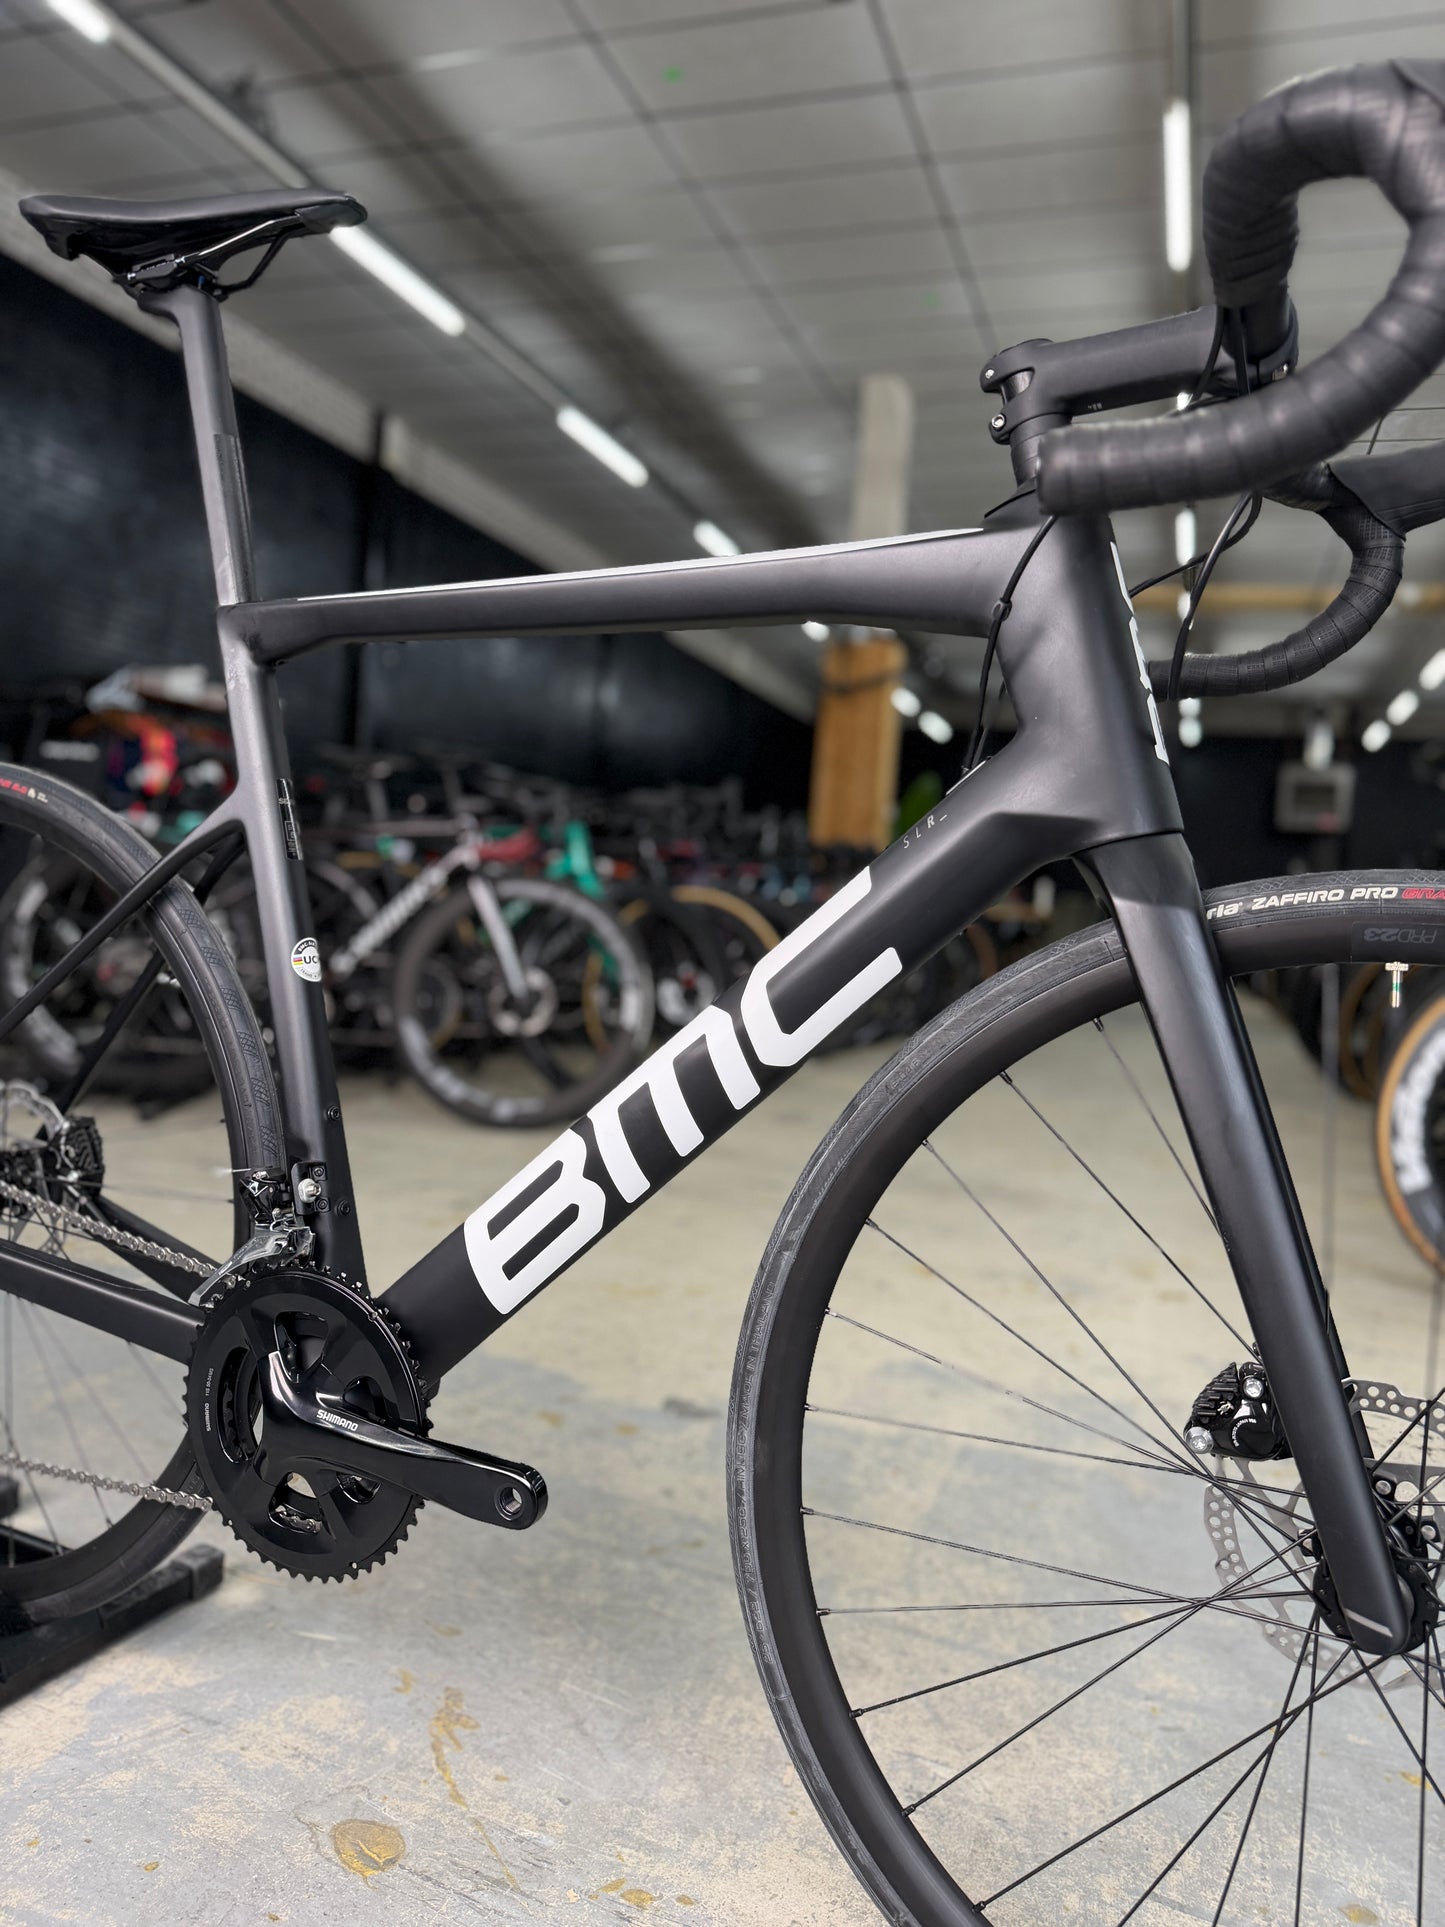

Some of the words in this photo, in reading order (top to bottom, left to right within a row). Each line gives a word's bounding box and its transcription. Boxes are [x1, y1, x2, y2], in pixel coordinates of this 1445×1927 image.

[1252, 889, 1344, 911] ZAFFIRO
[1350, 887, 1398, 900] PRO
[1363, 928, 1438, 944] PRD23
[464, 866, 903, 1315] BMC
[751, 1281, 776, 1352] THAILAND
[316, 1409, 359, 1432] SHIMANO
